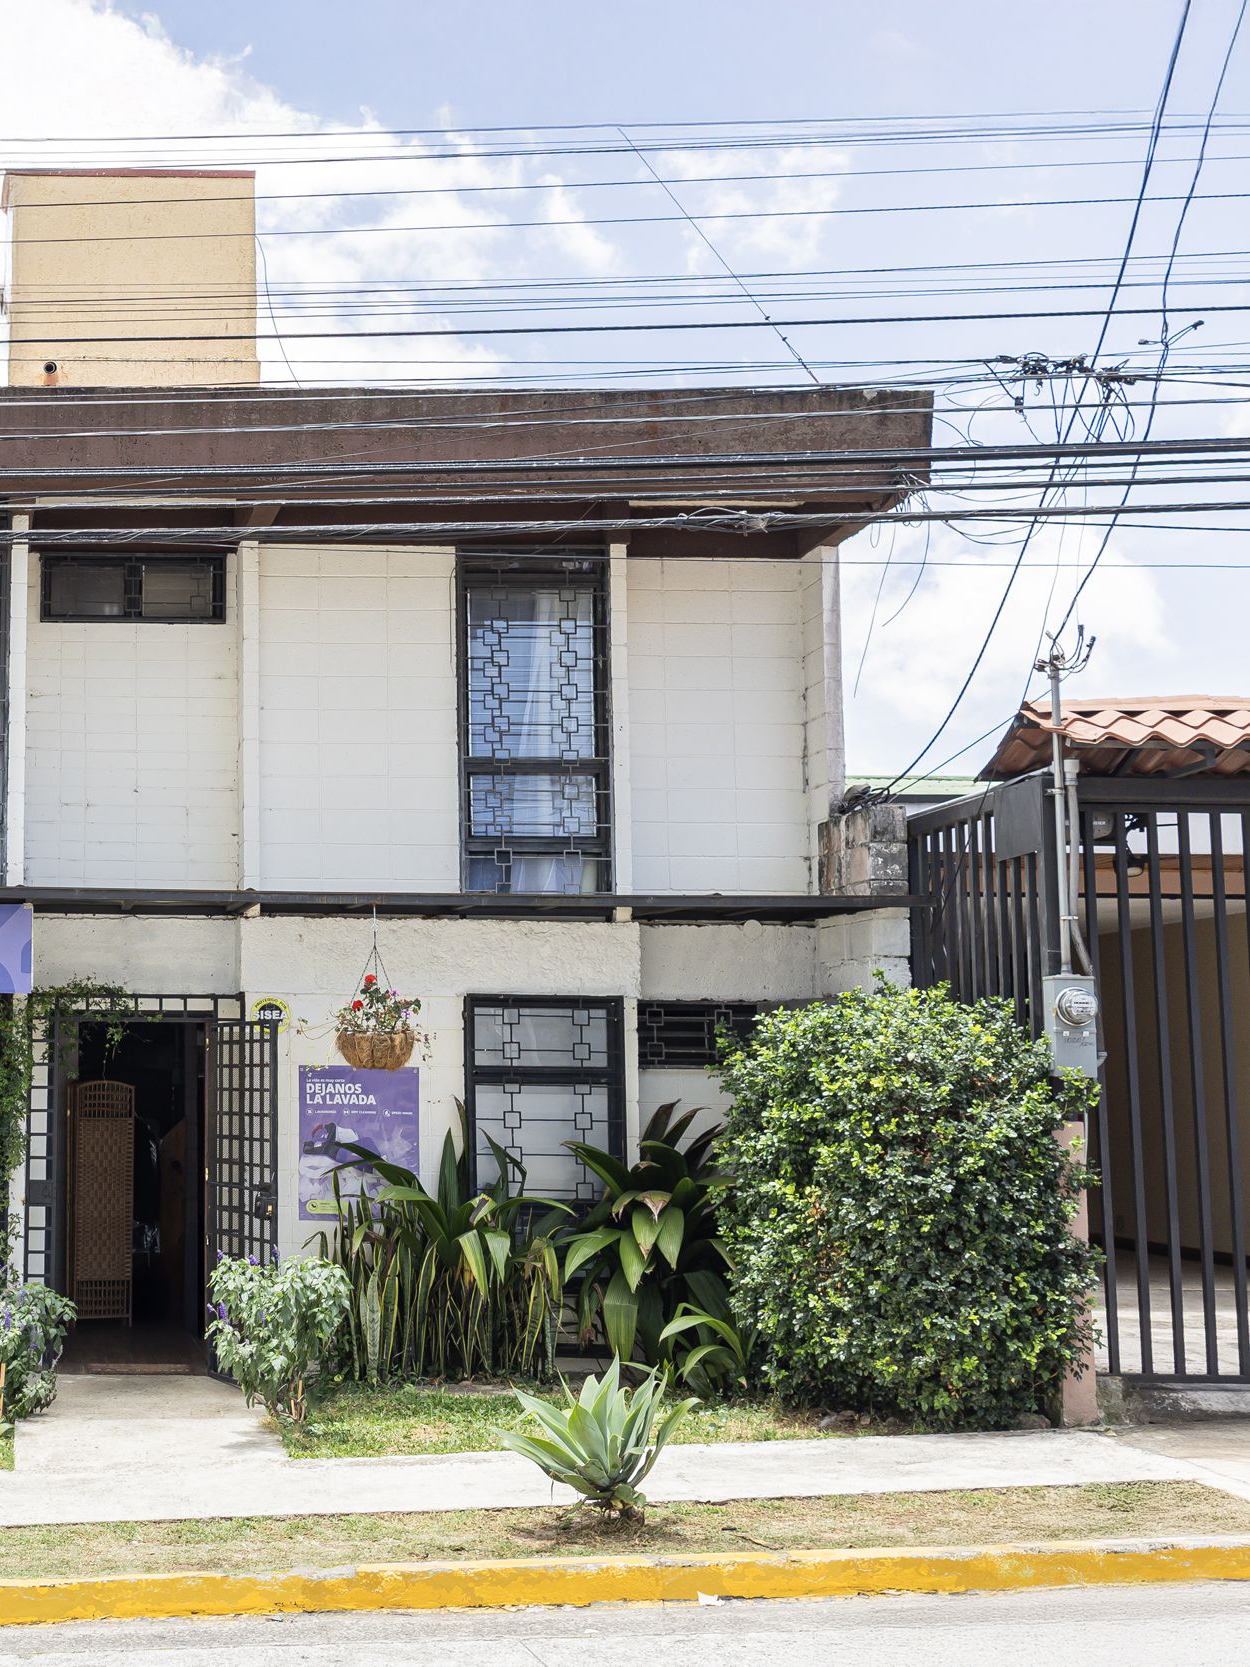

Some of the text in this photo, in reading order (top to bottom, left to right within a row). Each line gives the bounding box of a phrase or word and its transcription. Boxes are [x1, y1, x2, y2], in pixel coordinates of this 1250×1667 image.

[253, 1010, 287, 1020] SISEA
[306, 1083, 362, 1095] DEJANOS
[306, 1094, 376, 1105] LA LAVADA
